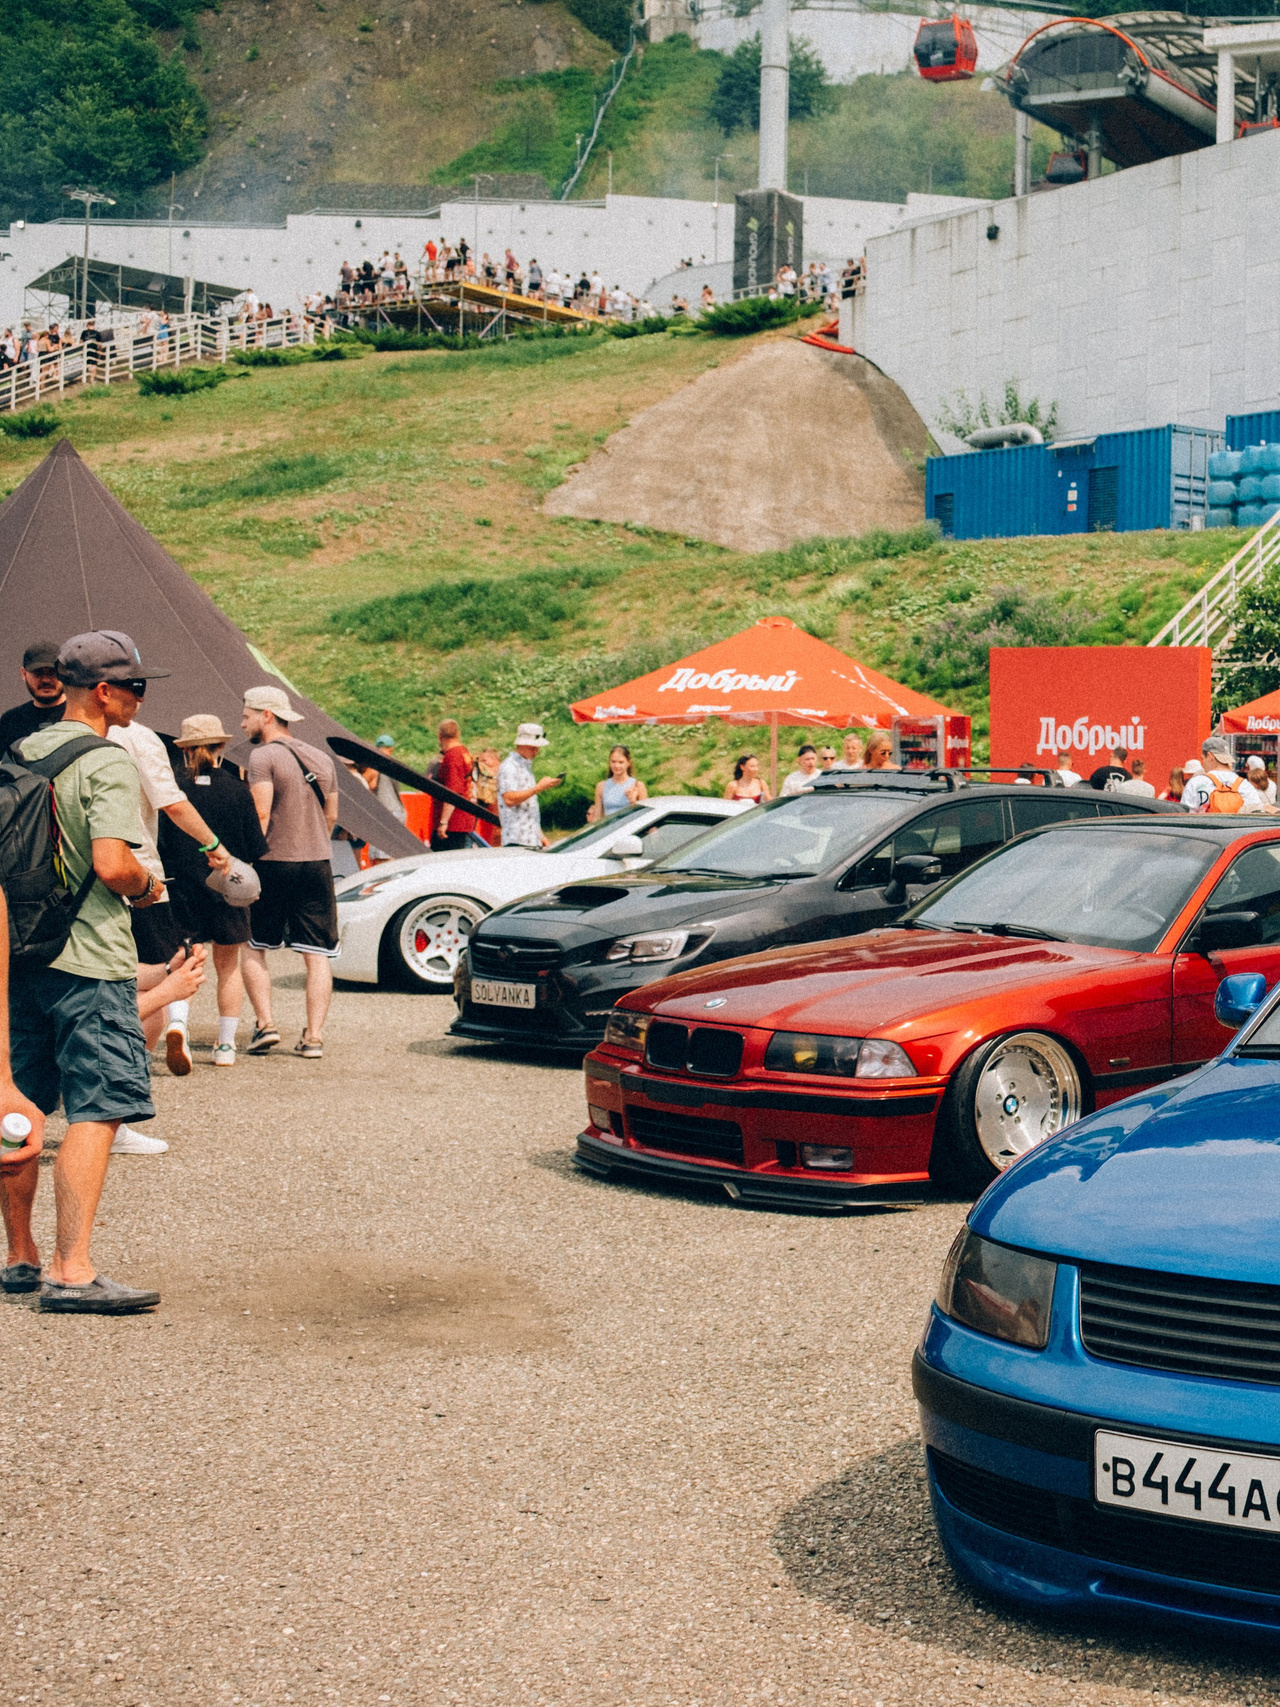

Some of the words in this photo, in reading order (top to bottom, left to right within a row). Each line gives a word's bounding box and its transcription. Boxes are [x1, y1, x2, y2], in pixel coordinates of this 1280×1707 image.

[657, 668, 797, 693] Добрый
[1036, 715, 1145, 756] Добрый
[474, 983, 531, 1006] SOLYANKA
